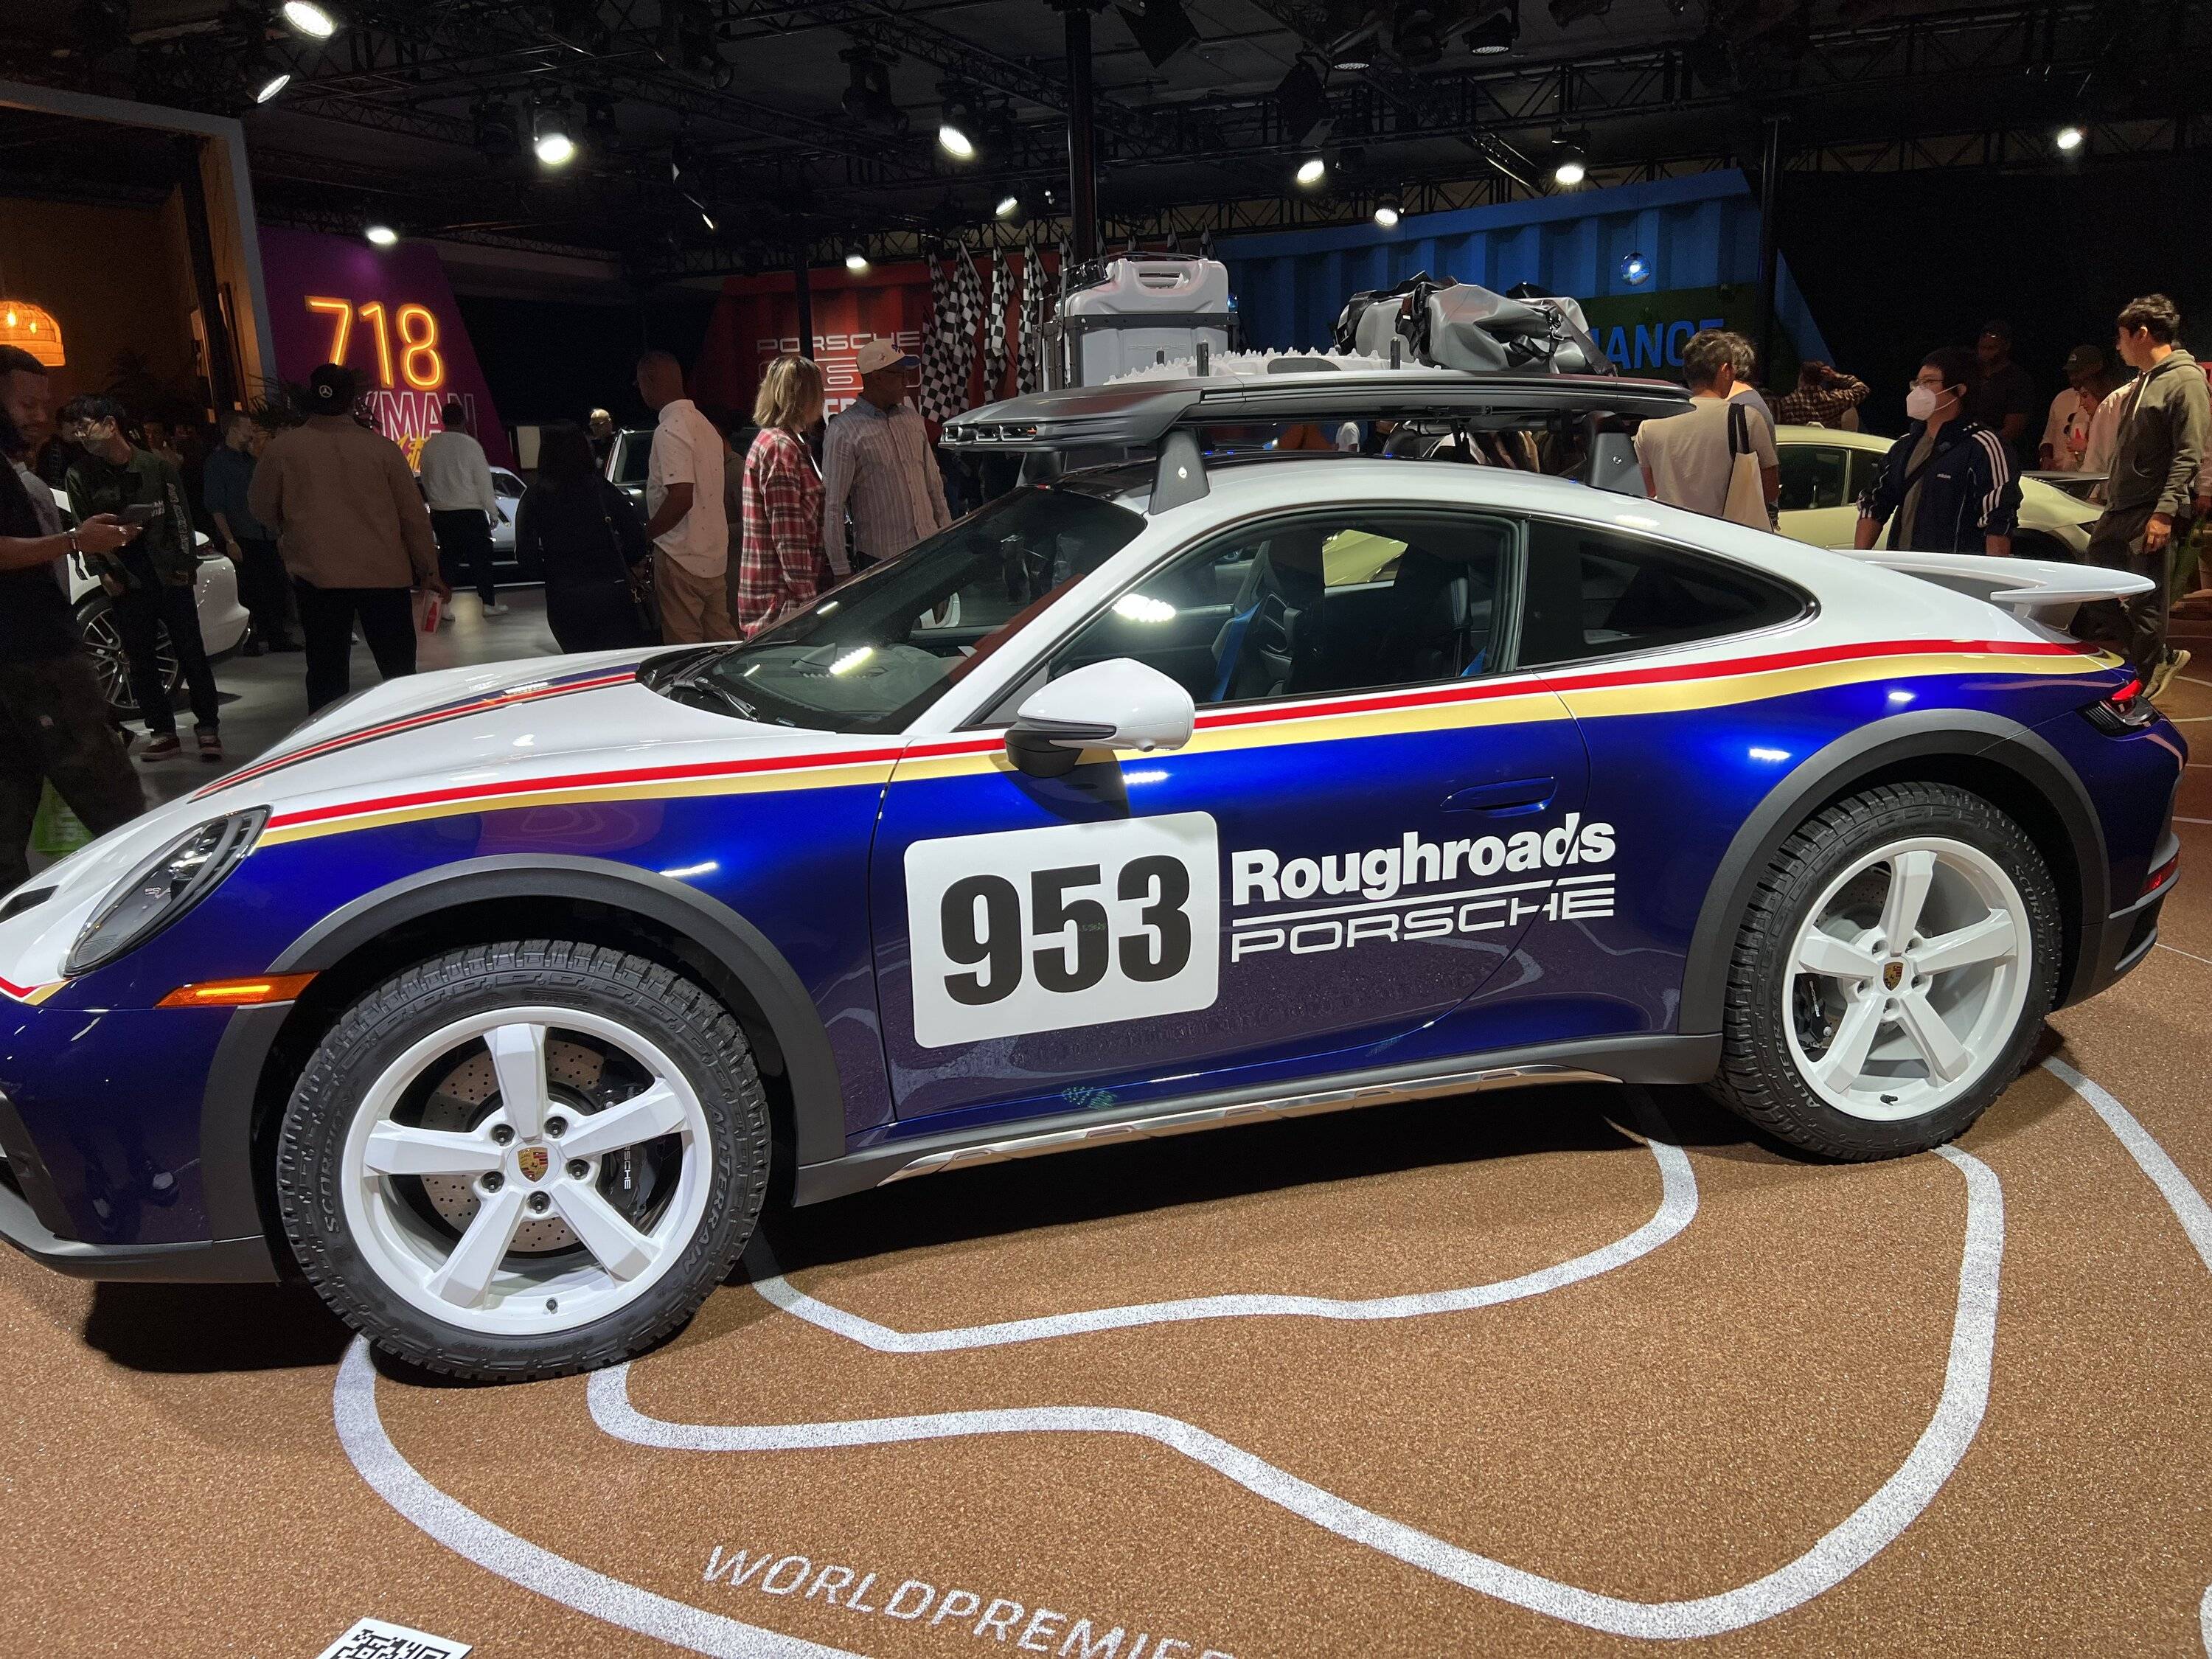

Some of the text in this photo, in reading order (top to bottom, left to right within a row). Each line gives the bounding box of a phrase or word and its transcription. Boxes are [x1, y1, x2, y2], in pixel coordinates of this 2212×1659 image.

[305, 296, 446, 391] 718
[1589, 318, 1725, 369] ANC
[1231, 812, 1616, 906] Roughroads
[940, 855, 1192, 1006] 953
[1231, 887, 1615, 963] PORSCHE
[703, 1545, 1236, 1659] WORLDPREMI
